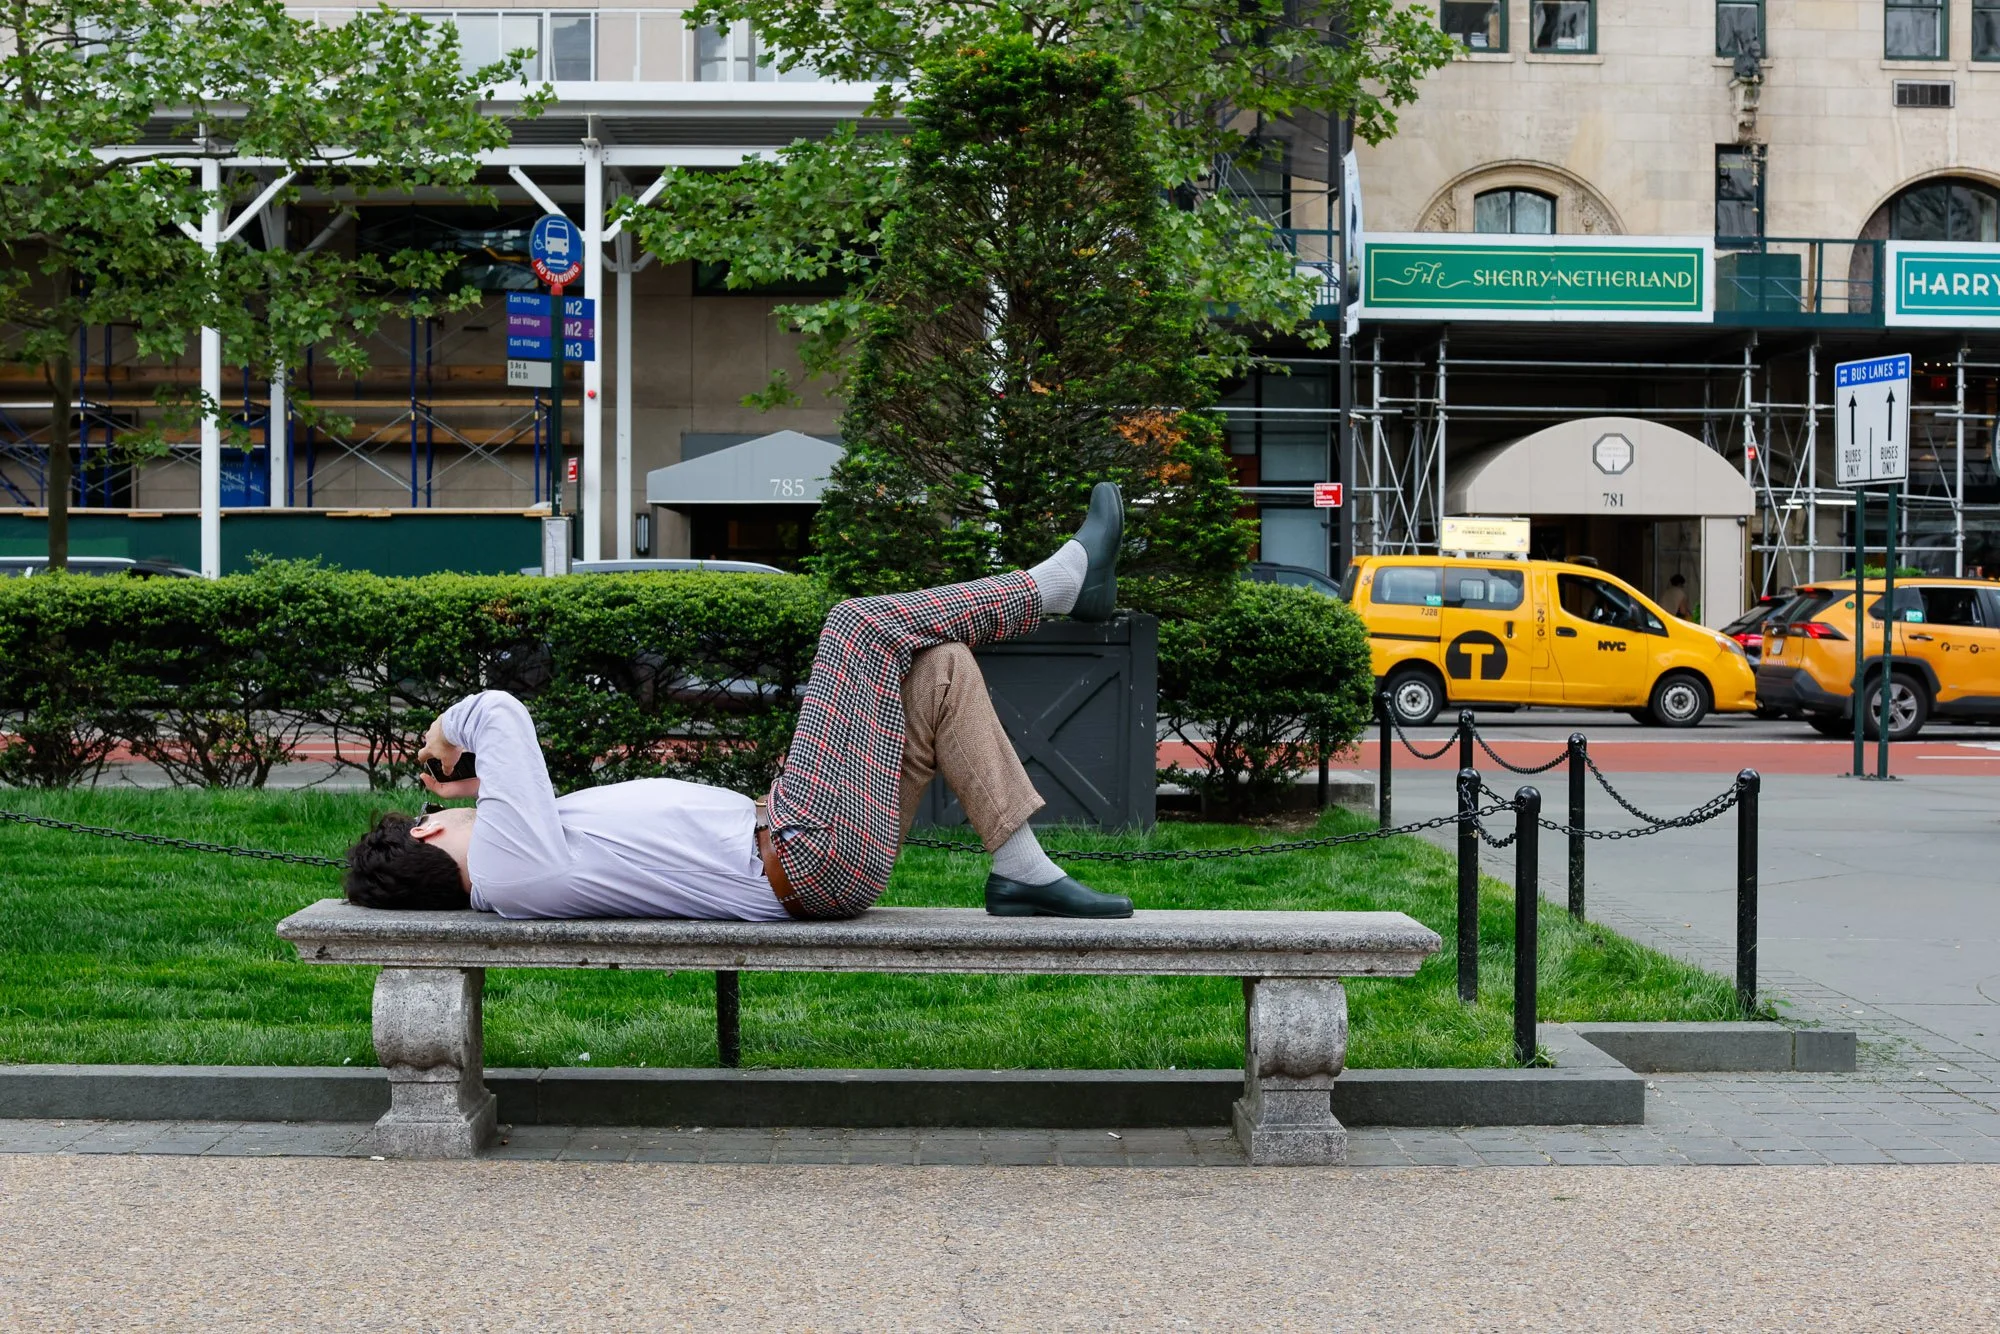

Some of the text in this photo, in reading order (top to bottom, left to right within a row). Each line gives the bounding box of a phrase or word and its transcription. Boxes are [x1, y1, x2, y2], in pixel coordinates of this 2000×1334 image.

[536, 261, 580, 284] NO STANDING
[1473, 269, 1692, 288] SHERRY-NETHERLAND
[509, 294, 541, 306] East Village
[565, 300, 583, 316] M2
[509, 316, 541, 328] East Village
[564, 321, 582, 337] M2
[509, 338, 541, 349] East Village
[565, 342, 583, 358] M3
[1851, 362, 1894, 382] BUS LANES
[1844, 449, 1861, 463] BUSES
[1880, 445, 1898, 460] BUSES
[1846, 463, 1859, 477] ONLY
[1882, 460, 1896, 475] ONLY
[769, 478, 805, 497] 785
[1602, 492, 1624, 507] 781
[1597, 640, 1627, 652] NYC
